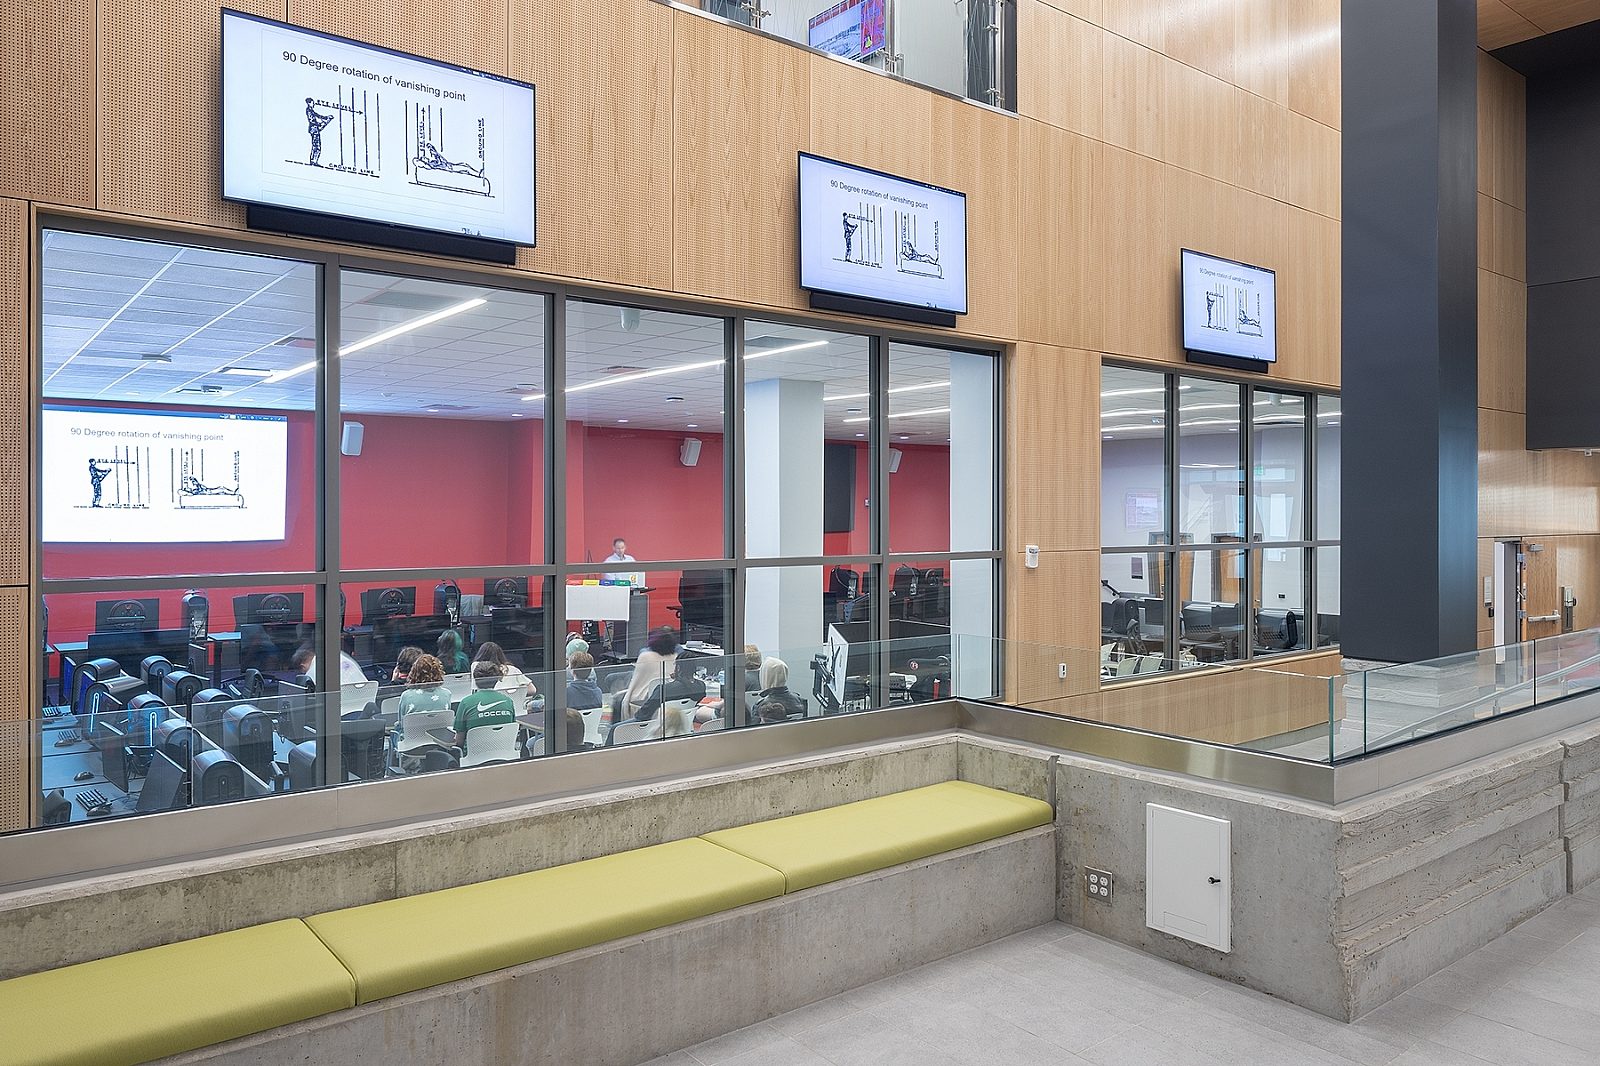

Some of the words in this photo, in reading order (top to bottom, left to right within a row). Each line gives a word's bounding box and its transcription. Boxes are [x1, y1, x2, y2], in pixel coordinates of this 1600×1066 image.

[282, 50, 297, 62] 90
[300, 55, 339, 71] Degree
[342, 66, 380, 82] rotation
[382, 75, 393, 85] of
[395, 79, 440, 97] vanishing
[443, 90, 466, 102] point
[830, 179, 839, 188] 90
[840, 181, 861, 193] Degree
[861, 188, 883, 199] rotation
[890, 195, 914, 208] vanishing
[915, 201, 929, 210] point
[70, 427, 82, 436] 90
[84, 427, 116, 438] Degree
[118, 430, 150, 438] rotation
[152, 431, 161, 439] of
[162, 432, 202, 442] vanishing
[203, 433, 224, 441] point
[478, 710, 511, 718] SOCCER
